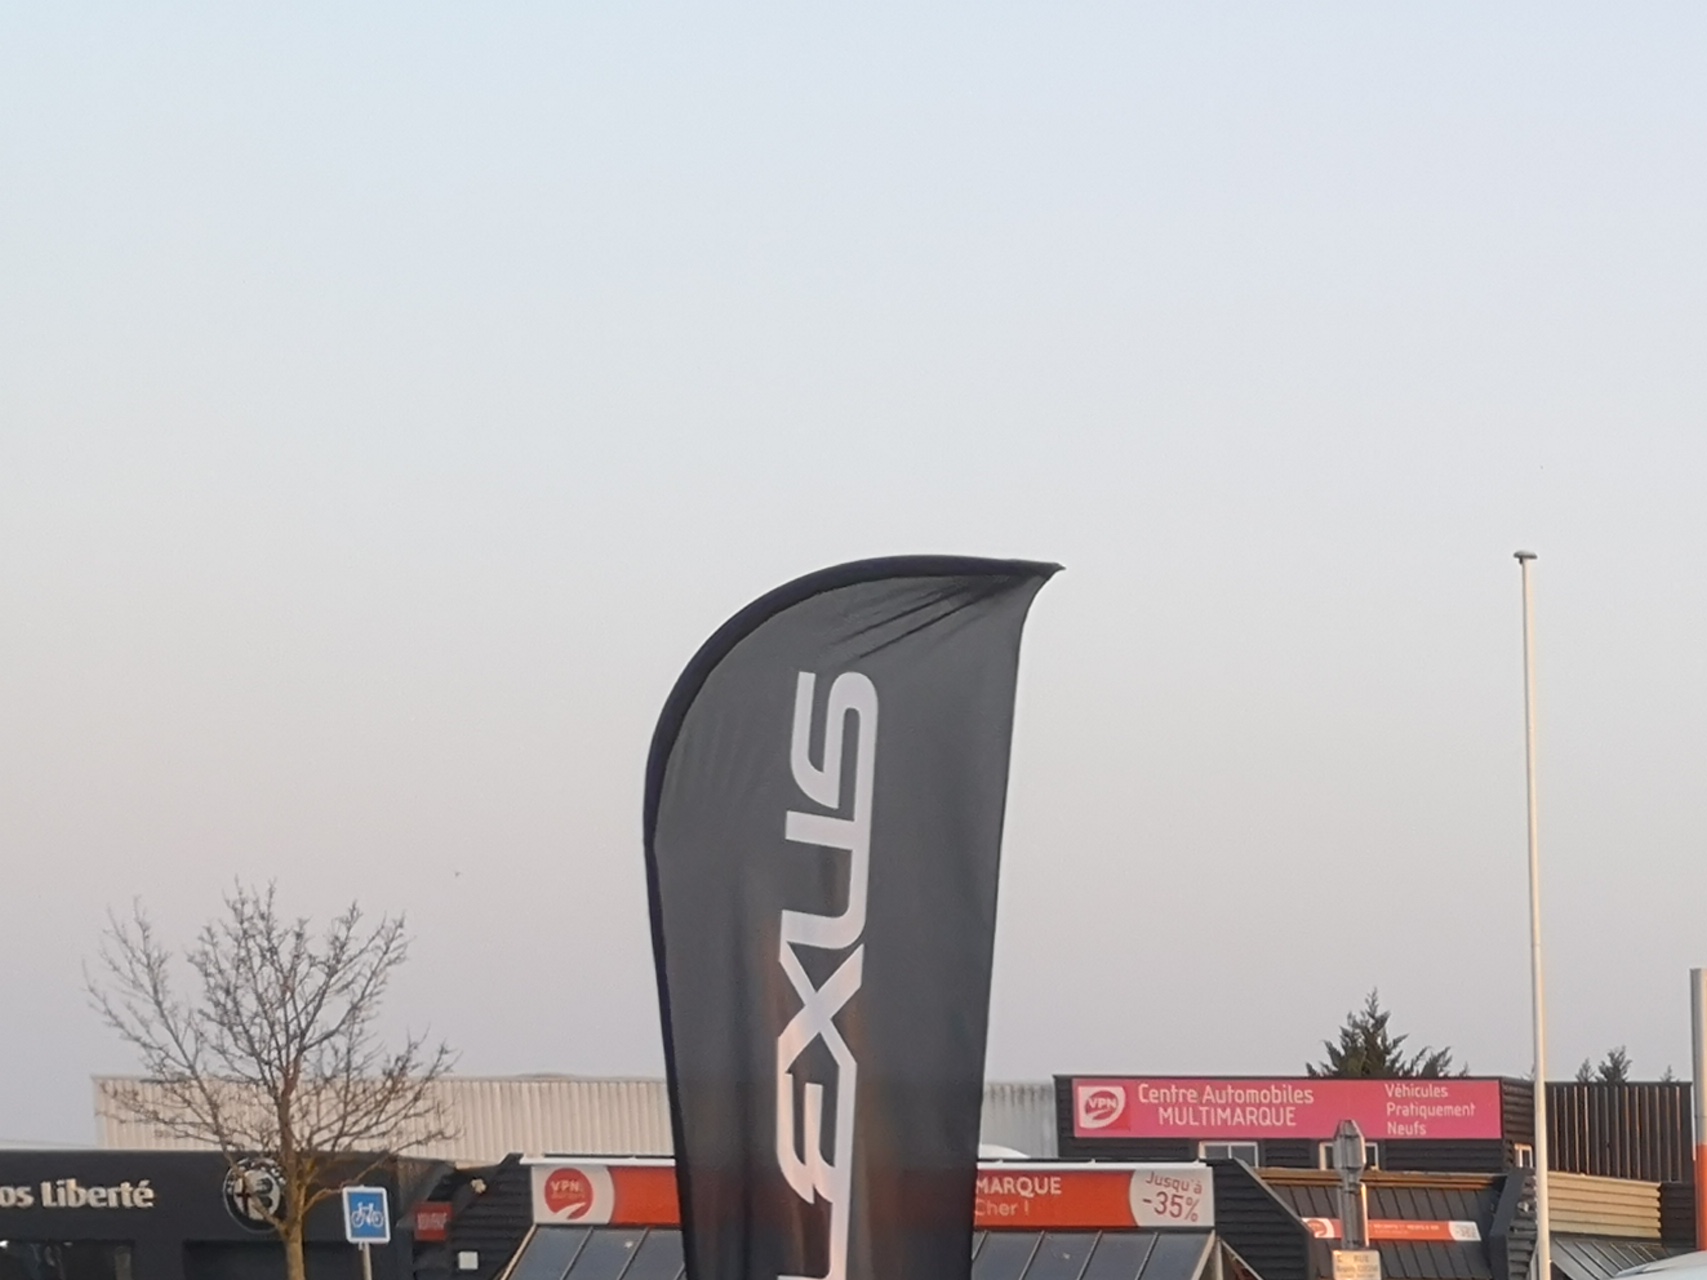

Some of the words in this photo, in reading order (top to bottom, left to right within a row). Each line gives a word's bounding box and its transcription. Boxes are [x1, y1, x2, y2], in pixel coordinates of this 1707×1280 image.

[1137, 1083, 1200, 1104] Centre
[1202, 1083, 1315, 1105] Automobiles
[1384, 1083, 1449, 1099] Véhicules
[1088, 1096, 1119, 1109] VPN
[1385, 1101, 1477, 1120] Pratiquement
[1157, 1106, 1298, 1127] MULTIMARQUE
[1386, 1121, 1428, 1136] Neufs
[40, 1178, 155, 1208] Liberté
[975, 1176, 1063, 1198] MARQUE
[1144, 1171, 1204, 1195] Jusqu'à
[974, 1198, 1018, 1217] Cher
[1142, 1190, 1200, 1223] -35%
